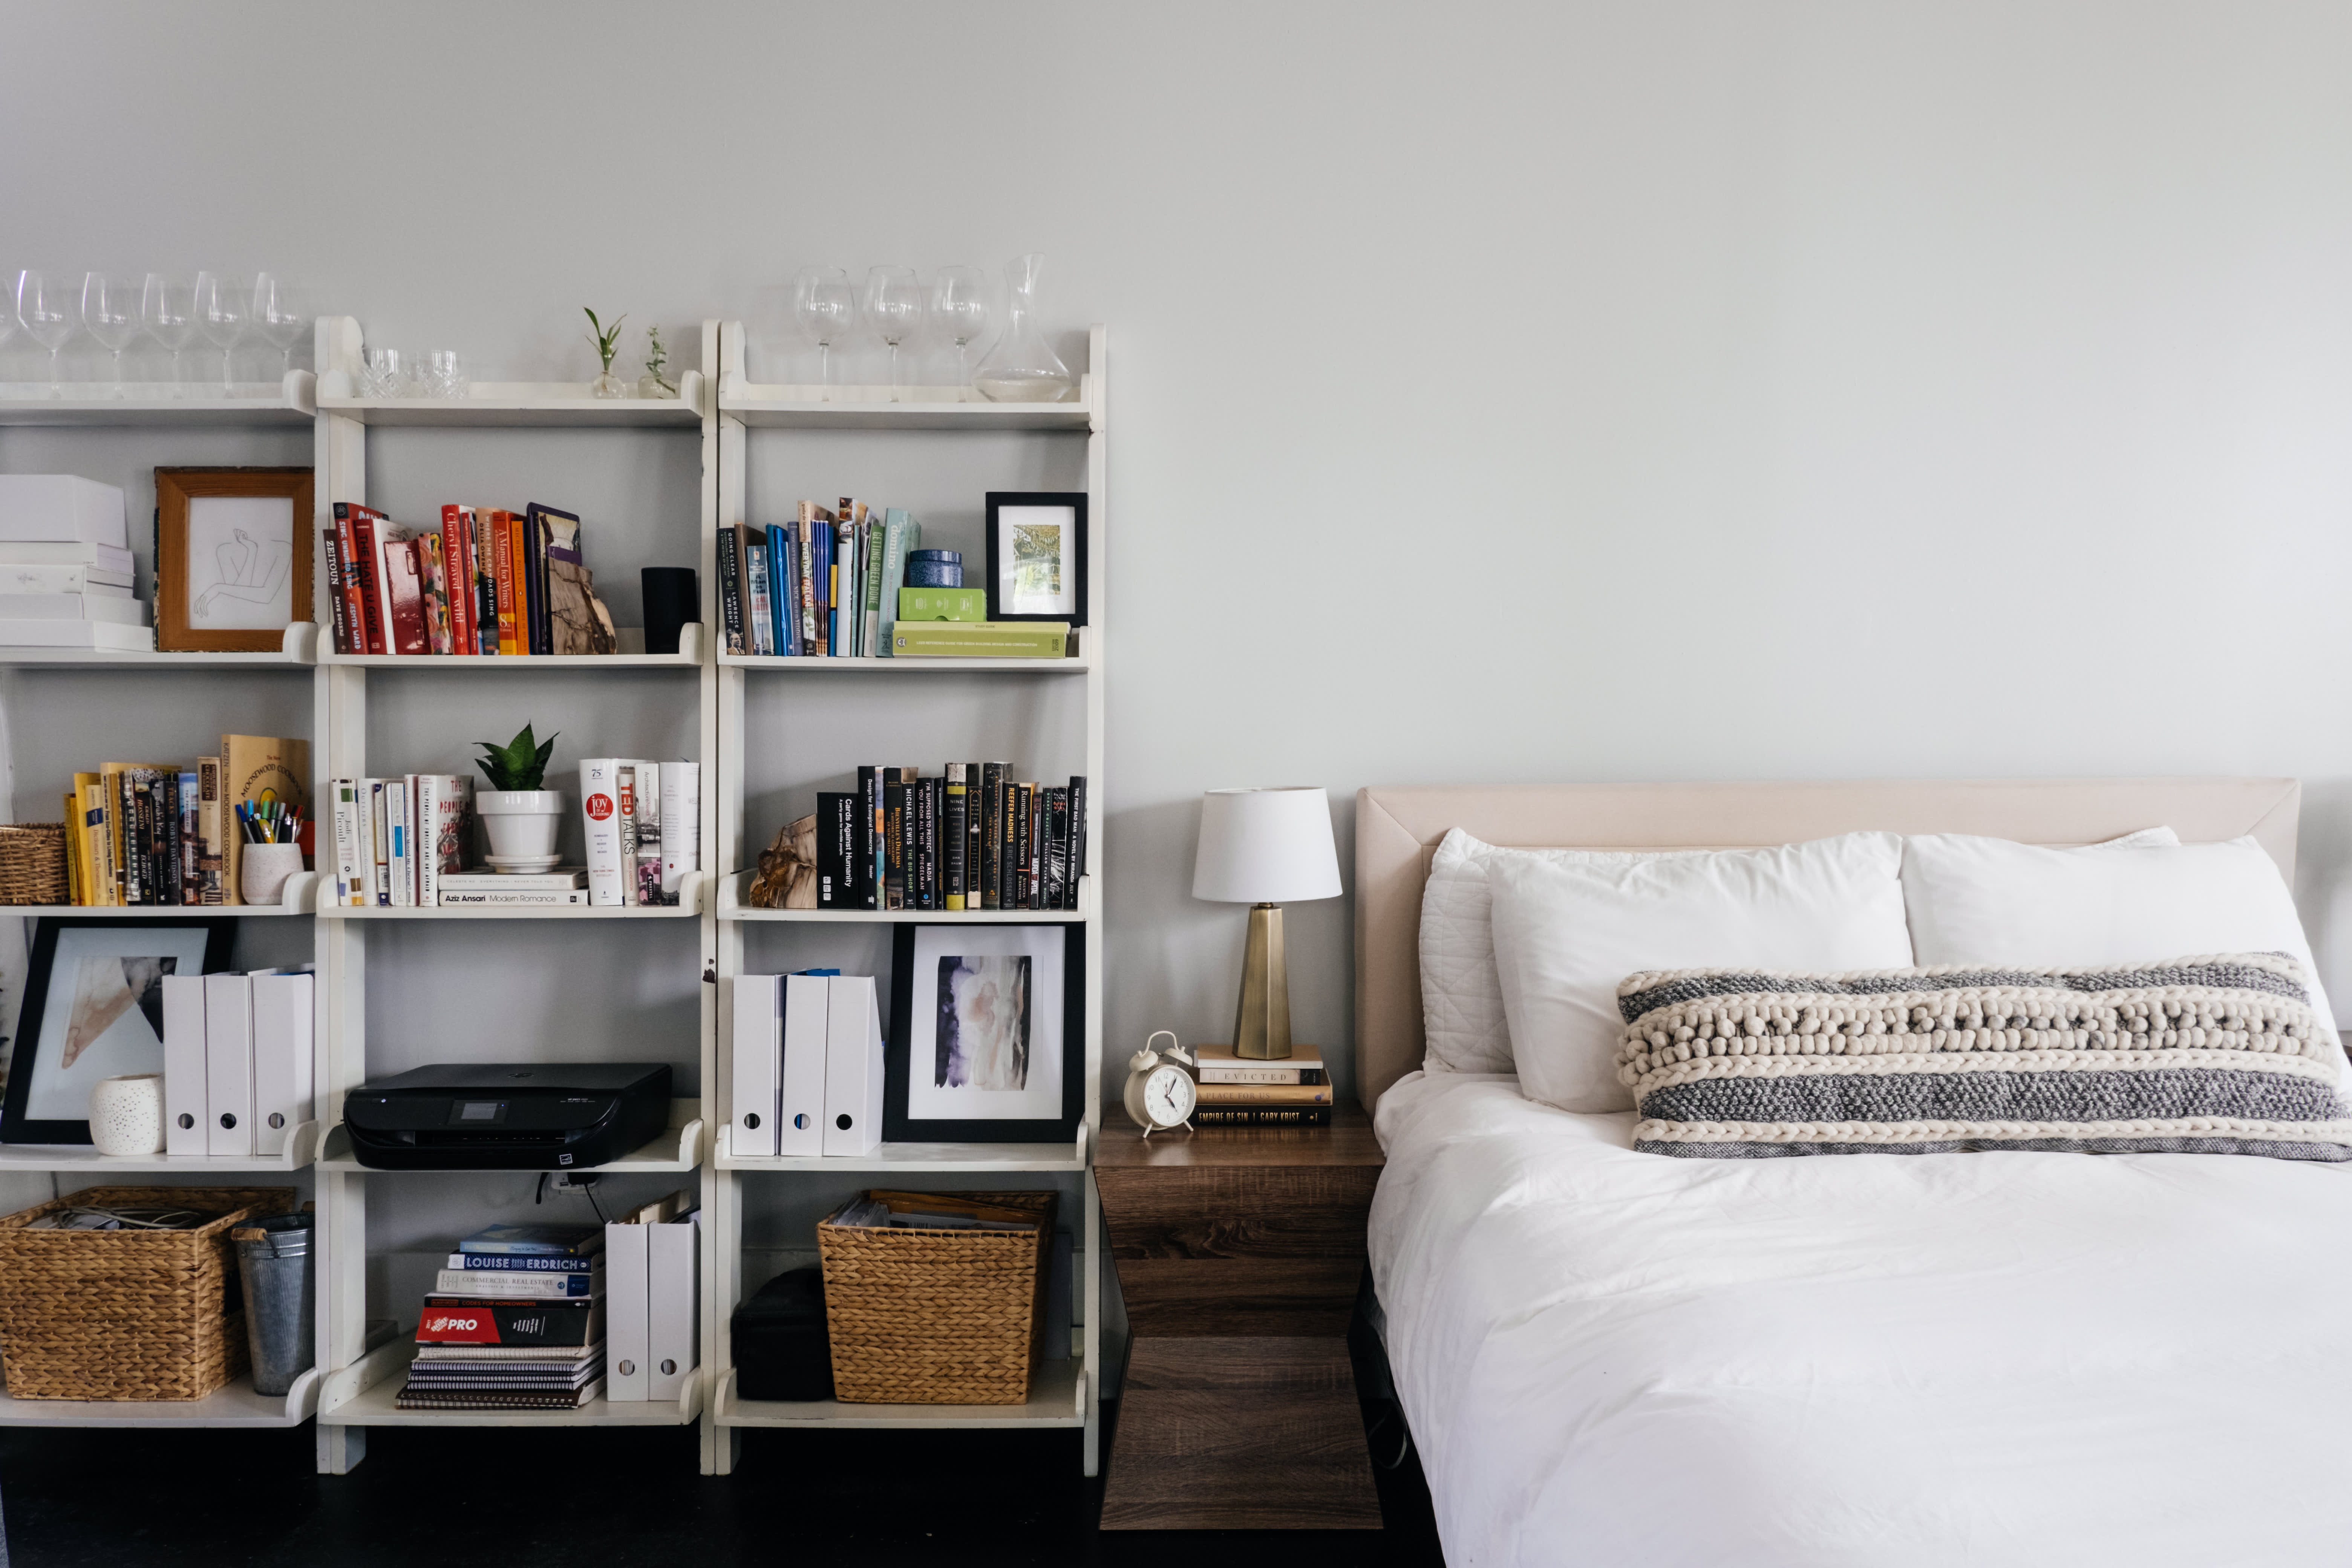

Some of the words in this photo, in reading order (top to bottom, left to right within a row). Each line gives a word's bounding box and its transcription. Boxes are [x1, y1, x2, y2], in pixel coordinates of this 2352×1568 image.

[447, 513, 458, 547] Cheryl
[359, 535, 369, 557] THE
[499, 538, 508, 567] Manual
[871, 532, 882, 560] GETTING
[888, 525, 899, 569] domino
[326, 541, 339, 585] ZEITOUN
[362, 561, 373, 591] HATE
[451, 551, 462, 589] Strayed
[870, 563, 880, 585] GREEN
[502, 582, 510, 608] Writers
[869, 586, 878, 604] DONE
[349, 603, 357, 628] JESMYN
[368, 606, 378, 634] GIVE
[241, 764, 275, 798] MOOSEWOOD
[591, 796, 608, 816] joy
[621, 783, 634, 815] TED
[1019, 791, 1027, 820] Running
[154, 823, 163, 834] Key
[337, 812, 346, 843] Picoult
[623, 816, 635, 854] TALKS
[1199, 1113, 1223, 1122] EMPIRE
[1227, 1113, 1234, 1122] OF
[1237, 1112, 1248, 1122] SIN
[1260, 1113, 1277, 1122] GARY
[1281, 1113, 1299, 1122] KRIST
[467, 1257, 509, 1268] LOUISE
[527, 1259, 577, 1269] ERDRICH
[448, 1319, 477, 1330] PRO
